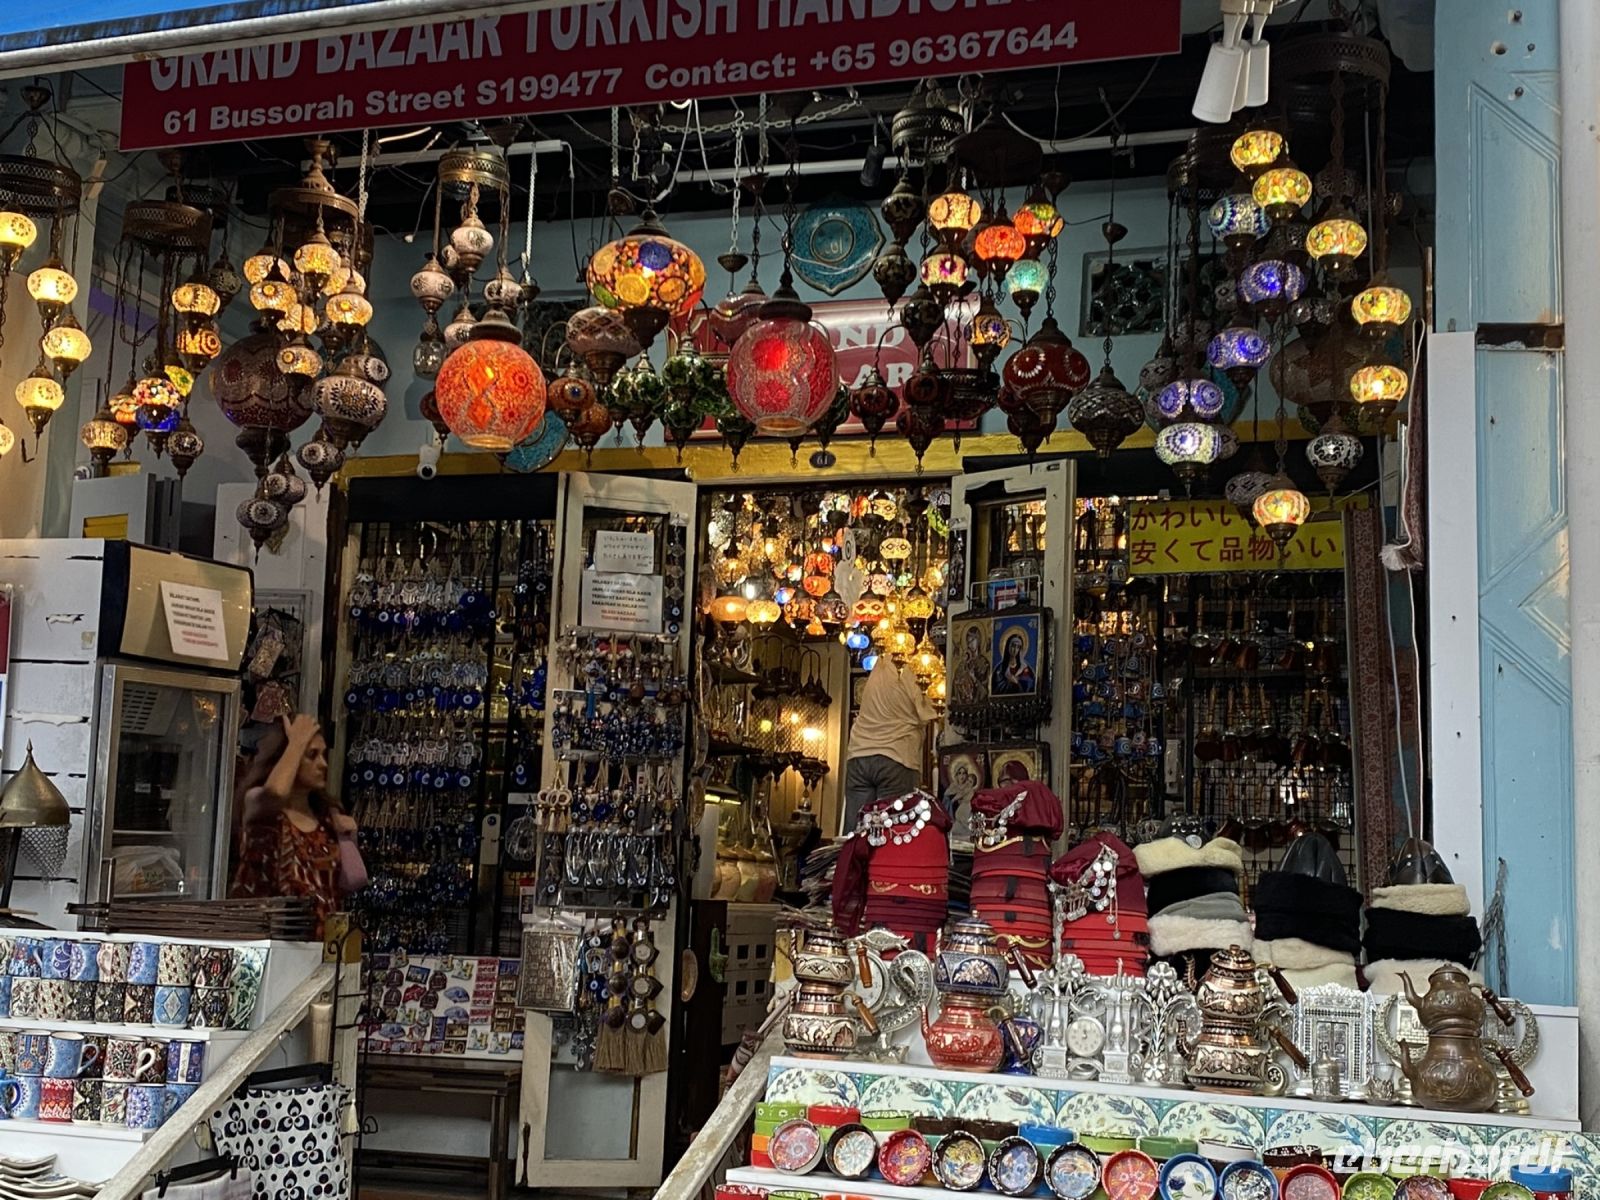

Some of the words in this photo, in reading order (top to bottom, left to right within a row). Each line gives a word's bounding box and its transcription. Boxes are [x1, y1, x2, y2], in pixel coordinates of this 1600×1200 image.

[163, 108, 196, 134] 61
[210, 95, 353, 130] Bussorah
[365, 83, 465, 115] Street
[476, 68, 623, 105] S199477
[645, 52, 796, 90] Contact:
[810, 43, 875, 72] +65
[888, 21, 1078, 66] 96367644
